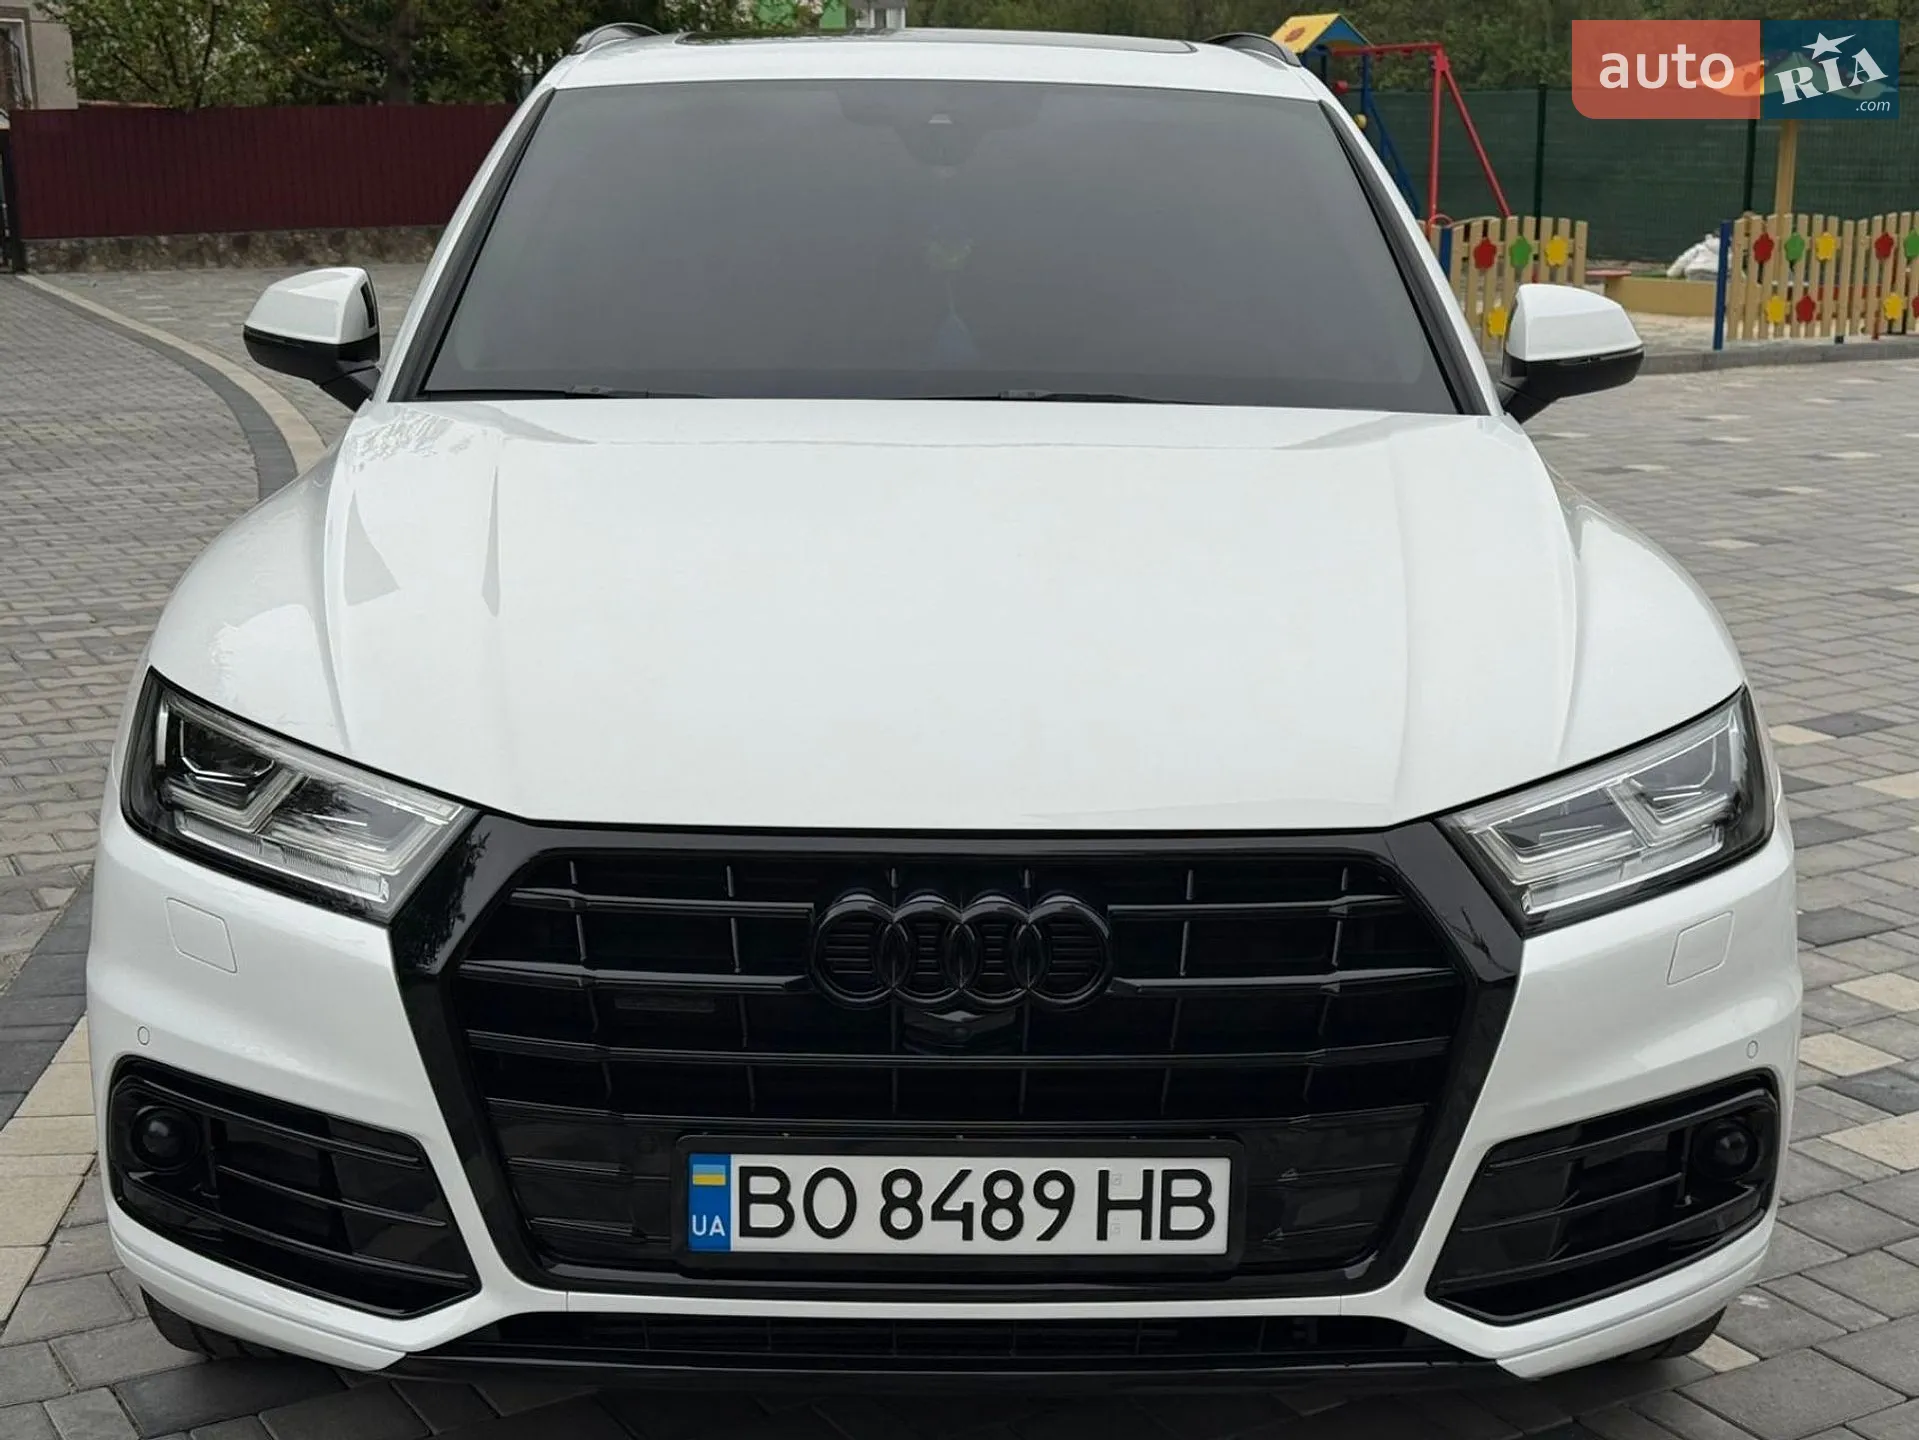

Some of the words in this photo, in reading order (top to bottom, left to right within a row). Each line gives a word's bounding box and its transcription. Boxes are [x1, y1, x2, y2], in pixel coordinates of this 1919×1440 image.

[691, 1215, 726, 1237] UA
[738, 1165, 858, 1239] BO
[879, 1167, 1076, 1241] 8489
[1096, 1168, 1216, 1241] HB
